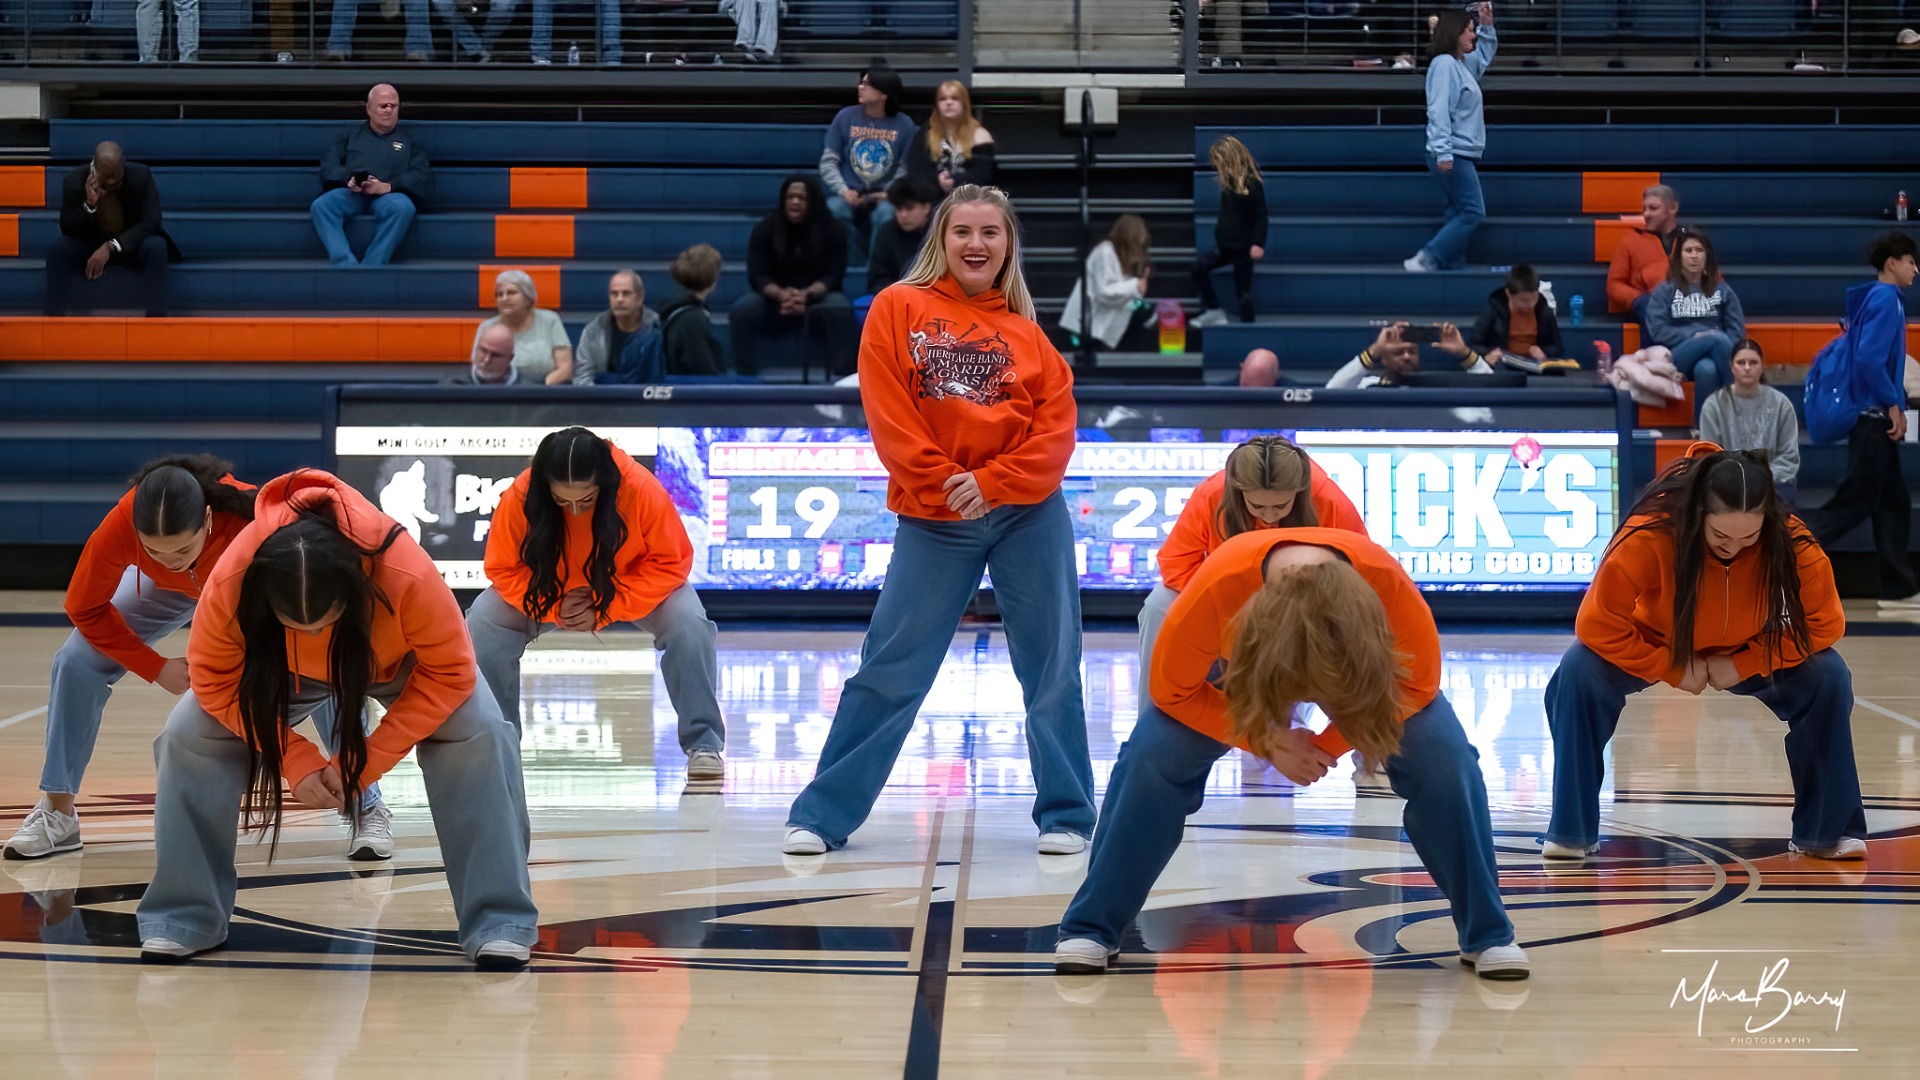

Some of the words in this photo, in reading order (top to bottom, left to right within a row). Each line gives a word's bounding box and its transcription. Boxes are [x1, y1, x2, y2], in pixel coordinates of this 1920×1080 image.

[928, 349, 976, 364] HERITAGE
[977, 354, 1006, 365] BAND
[937, 359, 991, 375] MARDI
[938, 368, 981, 386] GRAS
[377, 437, 409, 448] MINI
[415, 437, 448, 448] GOLF
[715, 448, 857, 470] HERITAGE
[746, 486, 840, 539] 19
